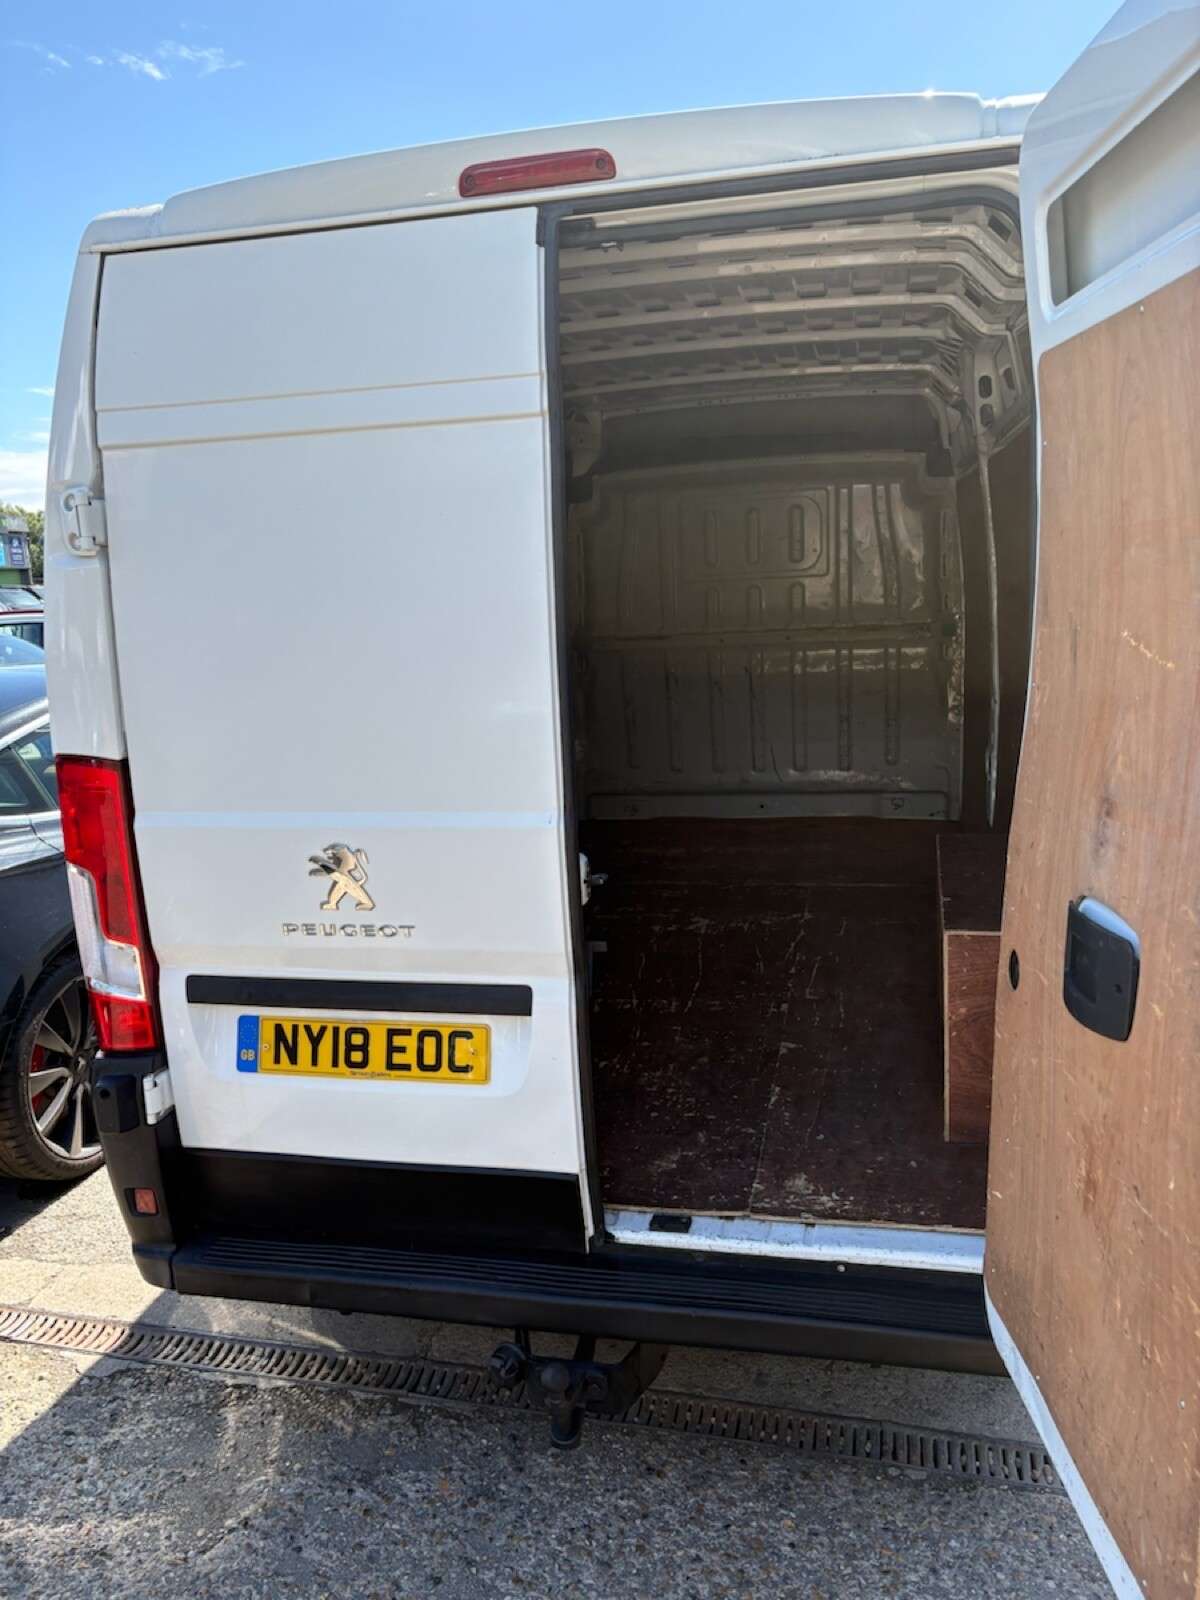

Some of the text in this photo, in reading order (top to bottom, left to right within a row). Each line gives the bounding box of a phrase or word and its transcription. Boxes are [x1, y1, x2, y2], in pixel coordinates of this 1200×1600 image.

[282, 923, 416, 938] PEUGEOT
[240, 1049, 256, 1061] GB
[273, 1023, 474, 1073] NY18 EOC
